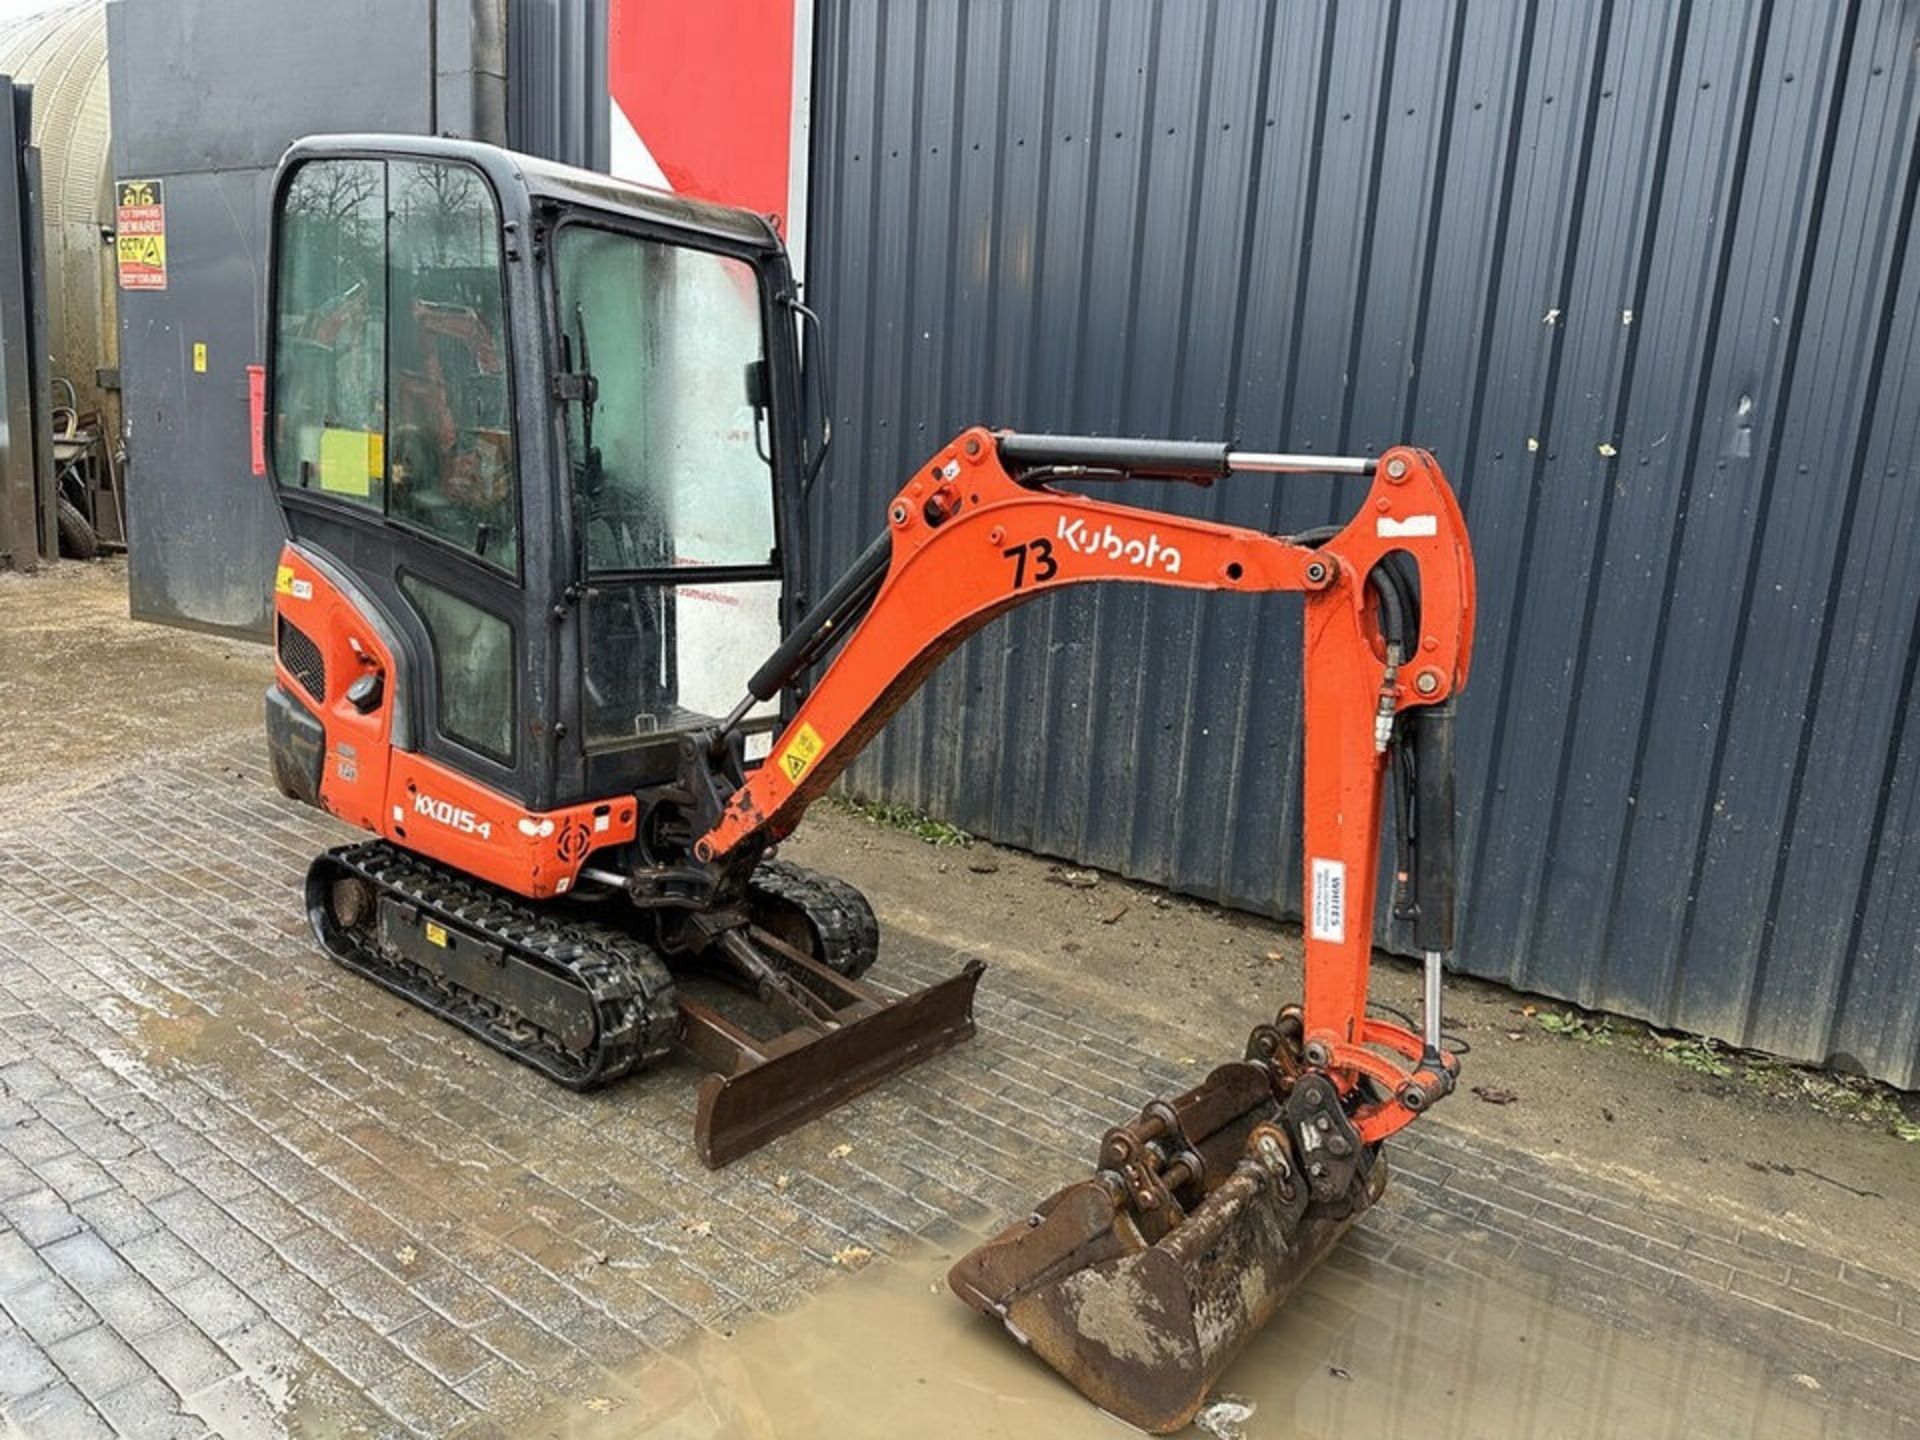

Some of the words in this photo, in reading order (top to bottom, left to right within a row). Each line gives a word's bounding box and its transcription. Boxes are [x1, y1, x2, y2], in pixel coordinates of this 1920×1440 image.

[120, 237, 145, 251] CCTV
[1003, 538, 1058, 588] 73
[1057, 515, 1182, 574] Kubota
[414, 793, 492, 840] KX015-4
[1331, 877, 1341, 926] WHITES
